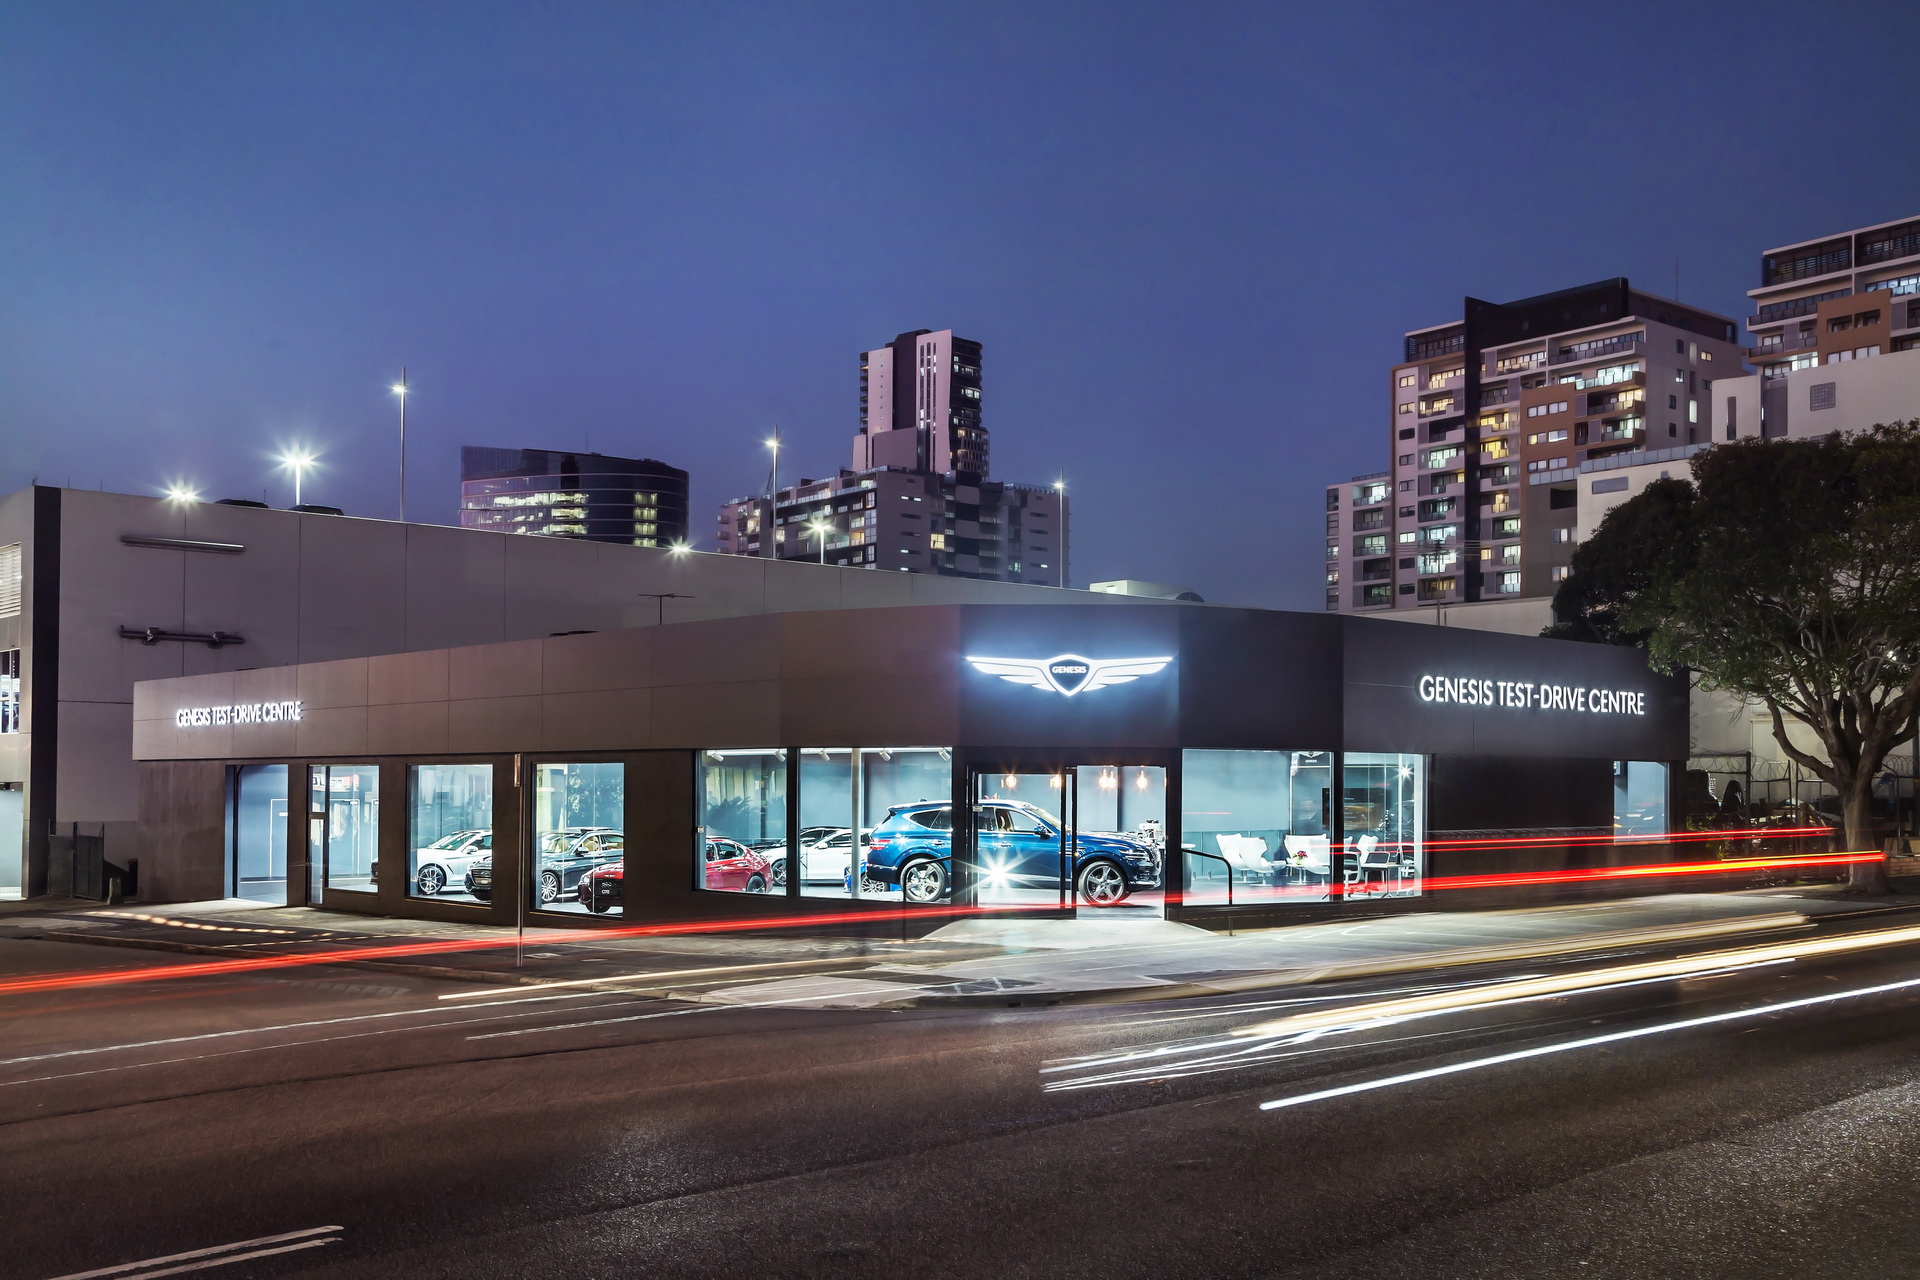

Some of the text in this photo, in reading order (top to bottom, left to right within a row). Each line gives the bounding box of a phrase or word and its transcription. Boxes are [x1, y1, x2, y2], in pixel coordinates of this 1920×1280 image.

[1419, 675, 1645, 715] GENESIS TEST-DRIVE CENTRE
[176, 701, 301, 727] GENESIS TEST-DRIVE CENTRE
